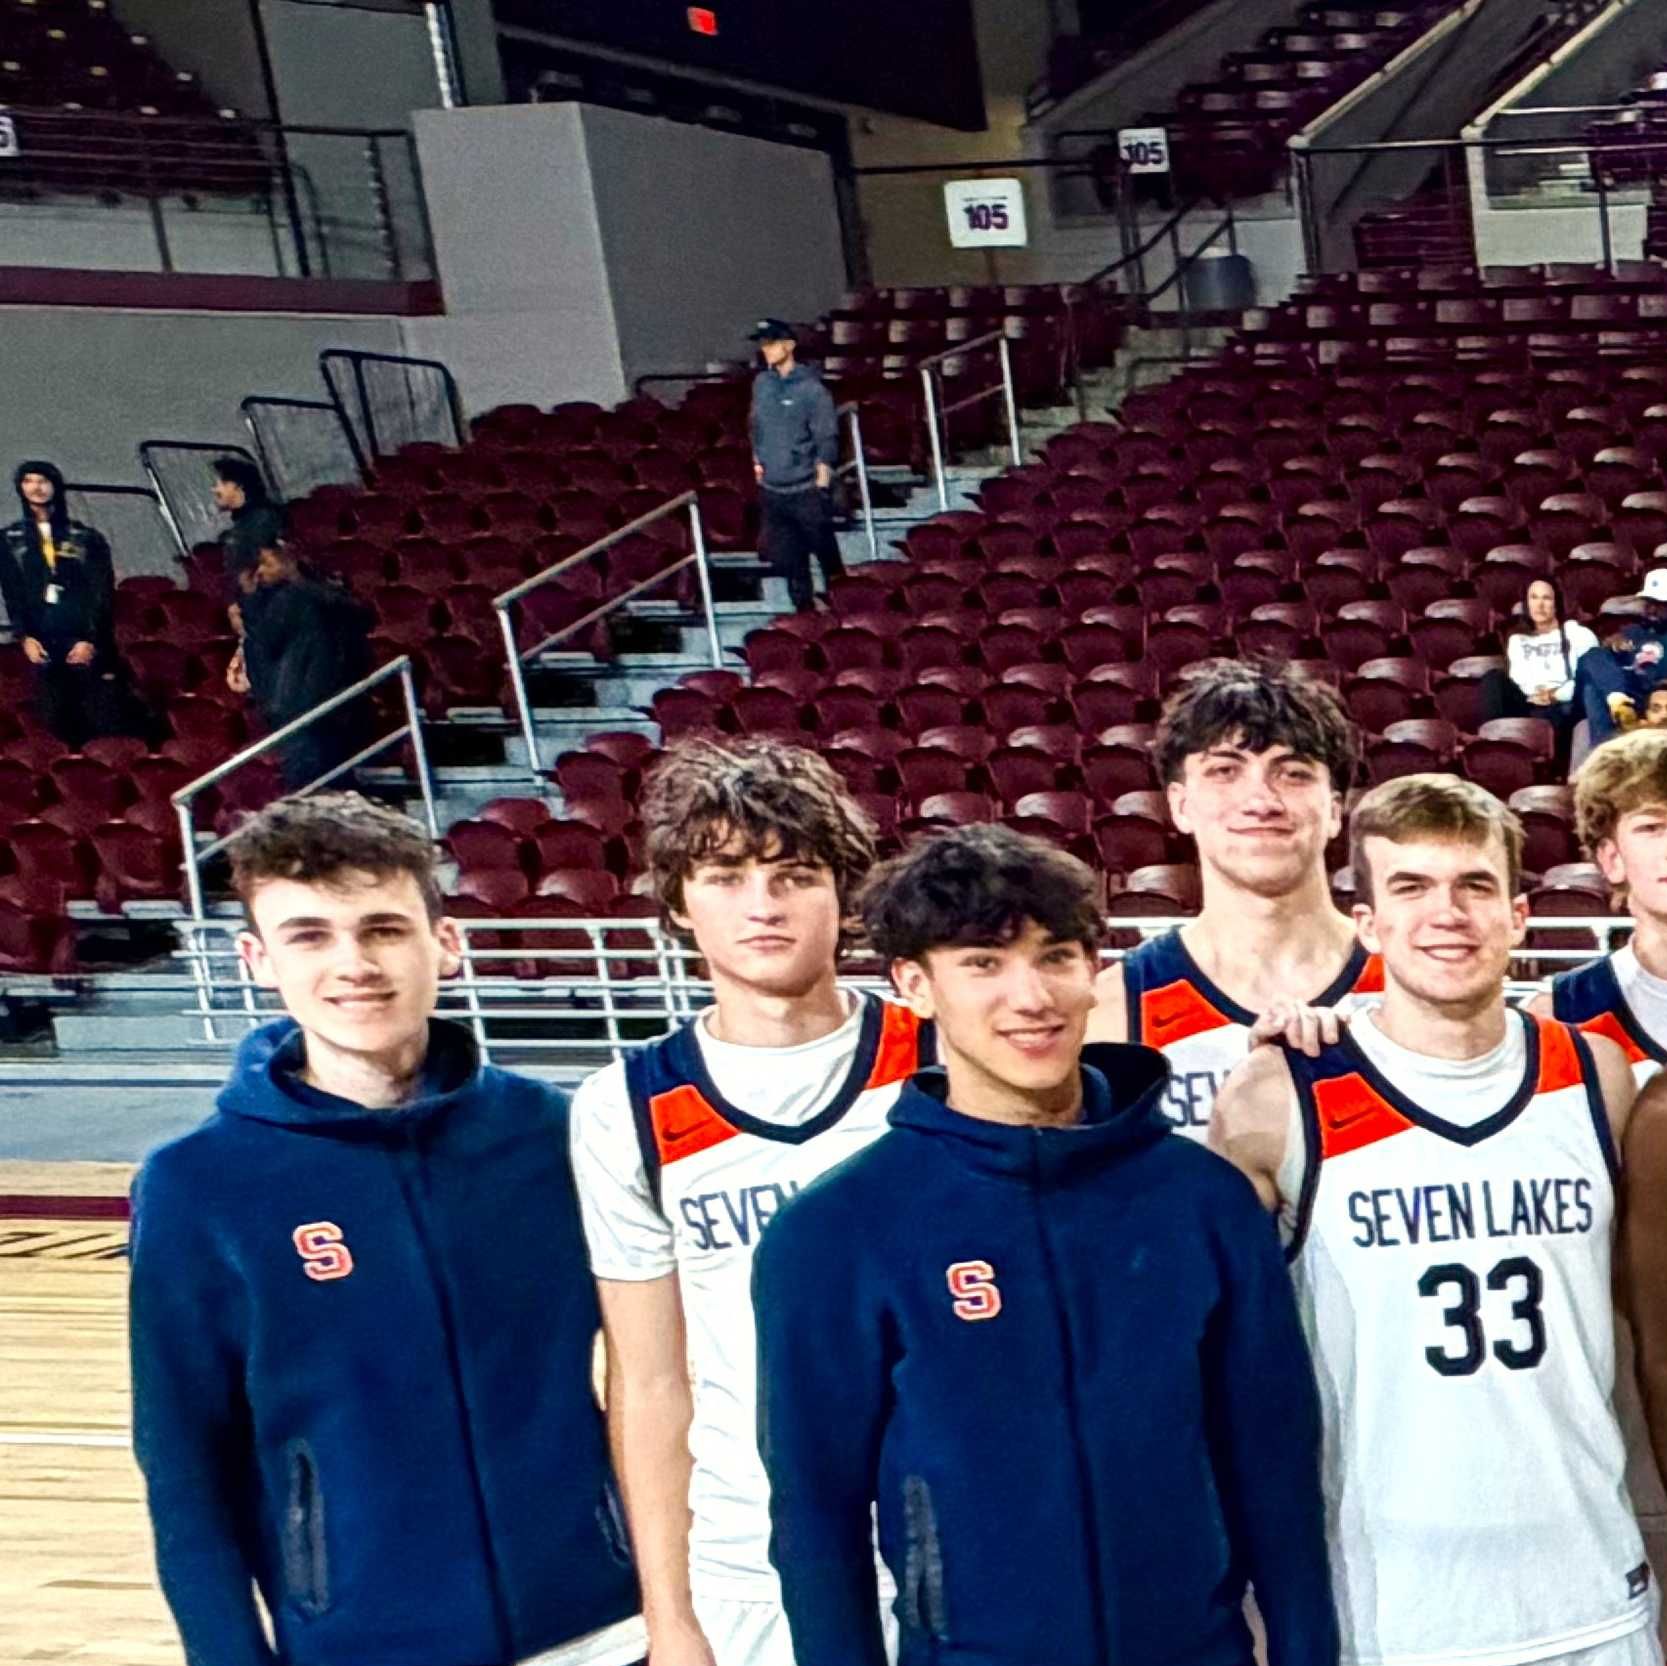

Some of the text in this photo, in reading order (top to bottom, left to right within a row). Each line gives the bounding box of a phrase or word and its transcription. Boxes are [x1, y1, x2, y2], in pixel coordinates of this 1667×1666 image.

[963, 204, 1009, 229] 105
[1349, 1178, 1593, 1247] SEVEN LAKES
[292, 1221, 356, 1281] S
[946, 1260, 1001, 1320] S
[1417, 1256, 1547, 1376] 33
